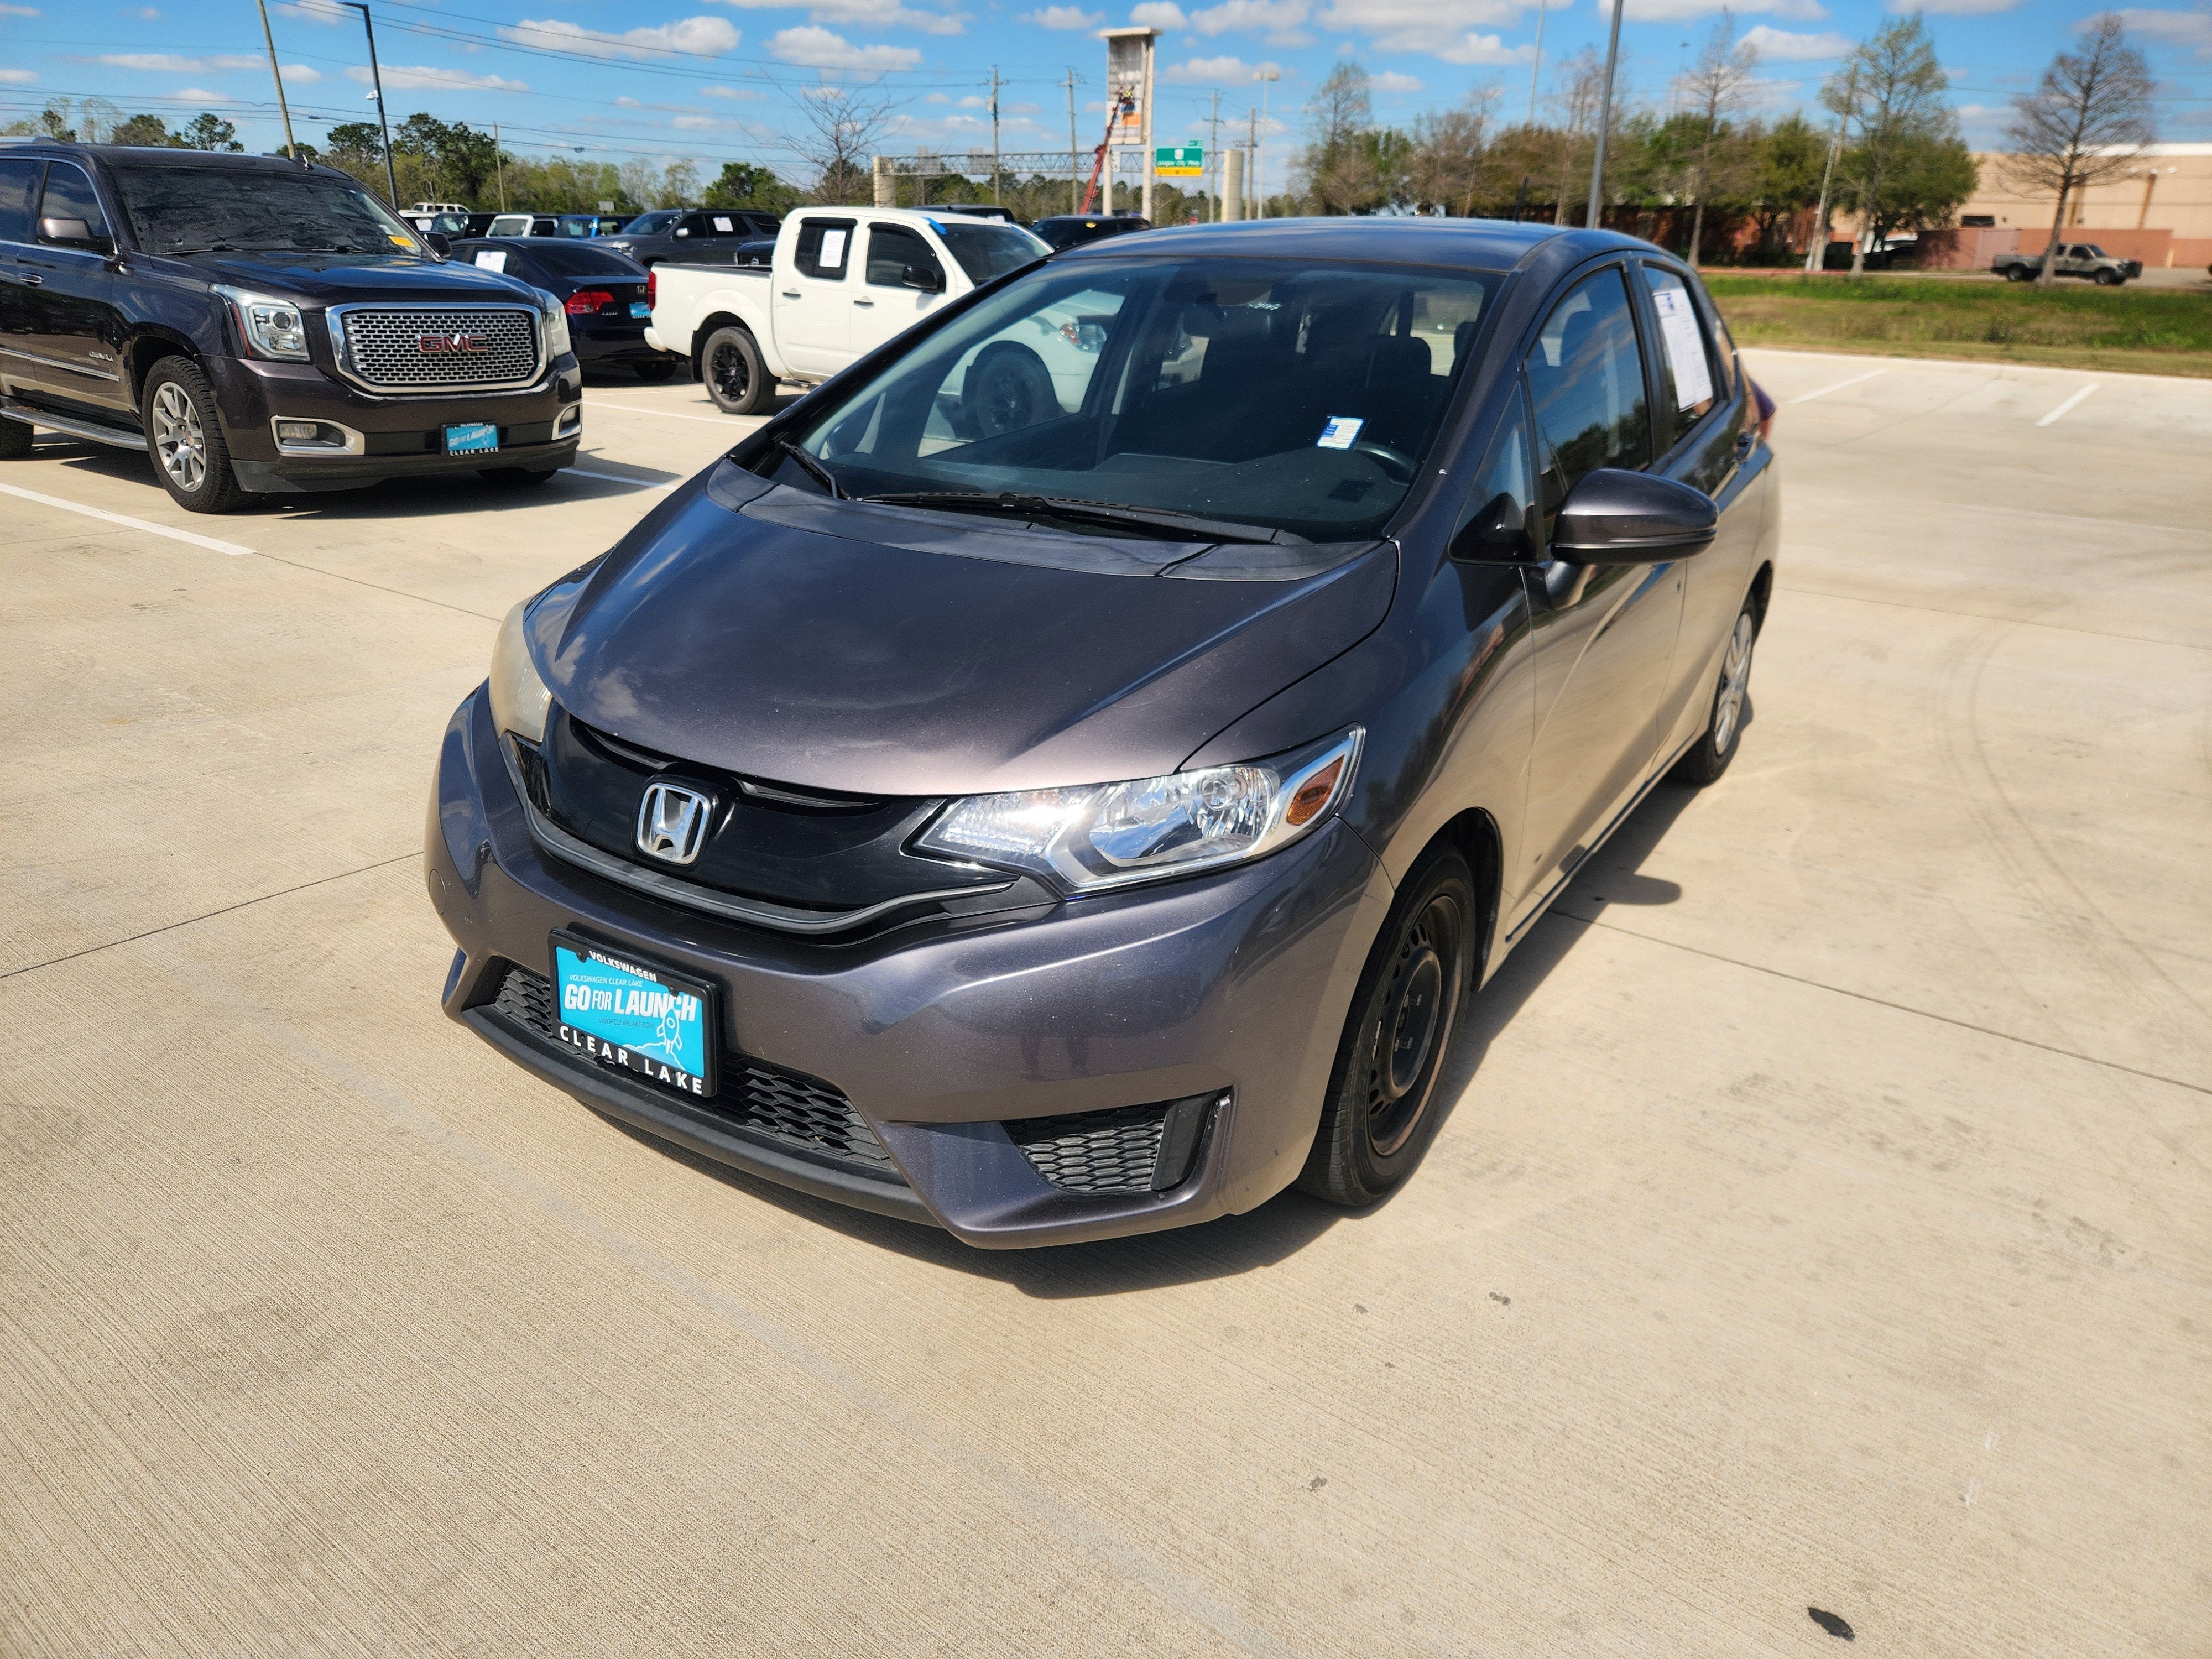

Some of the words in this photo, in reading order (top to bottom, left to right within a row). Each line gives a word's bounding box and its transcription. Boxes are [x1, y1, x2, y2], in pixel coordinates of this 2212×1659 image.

[420, 333, 488, 353] GMC
[570, 974, 608, 984] VOLKSWAGEN
[609, 977, 627, 986] CLEAR
[628, 979, 643, 988] LAKE
[589, 950, 657, 982] VOLKSWAGEN
[564, 984, 591, 1010] GO
[592, 990, 612, 1011] FOR
[614, 989, 697, 1021] LAUNCH
[559, 1026, 629, 1066] CLEAR
[645, 1059, 703, 1095] LAKE
